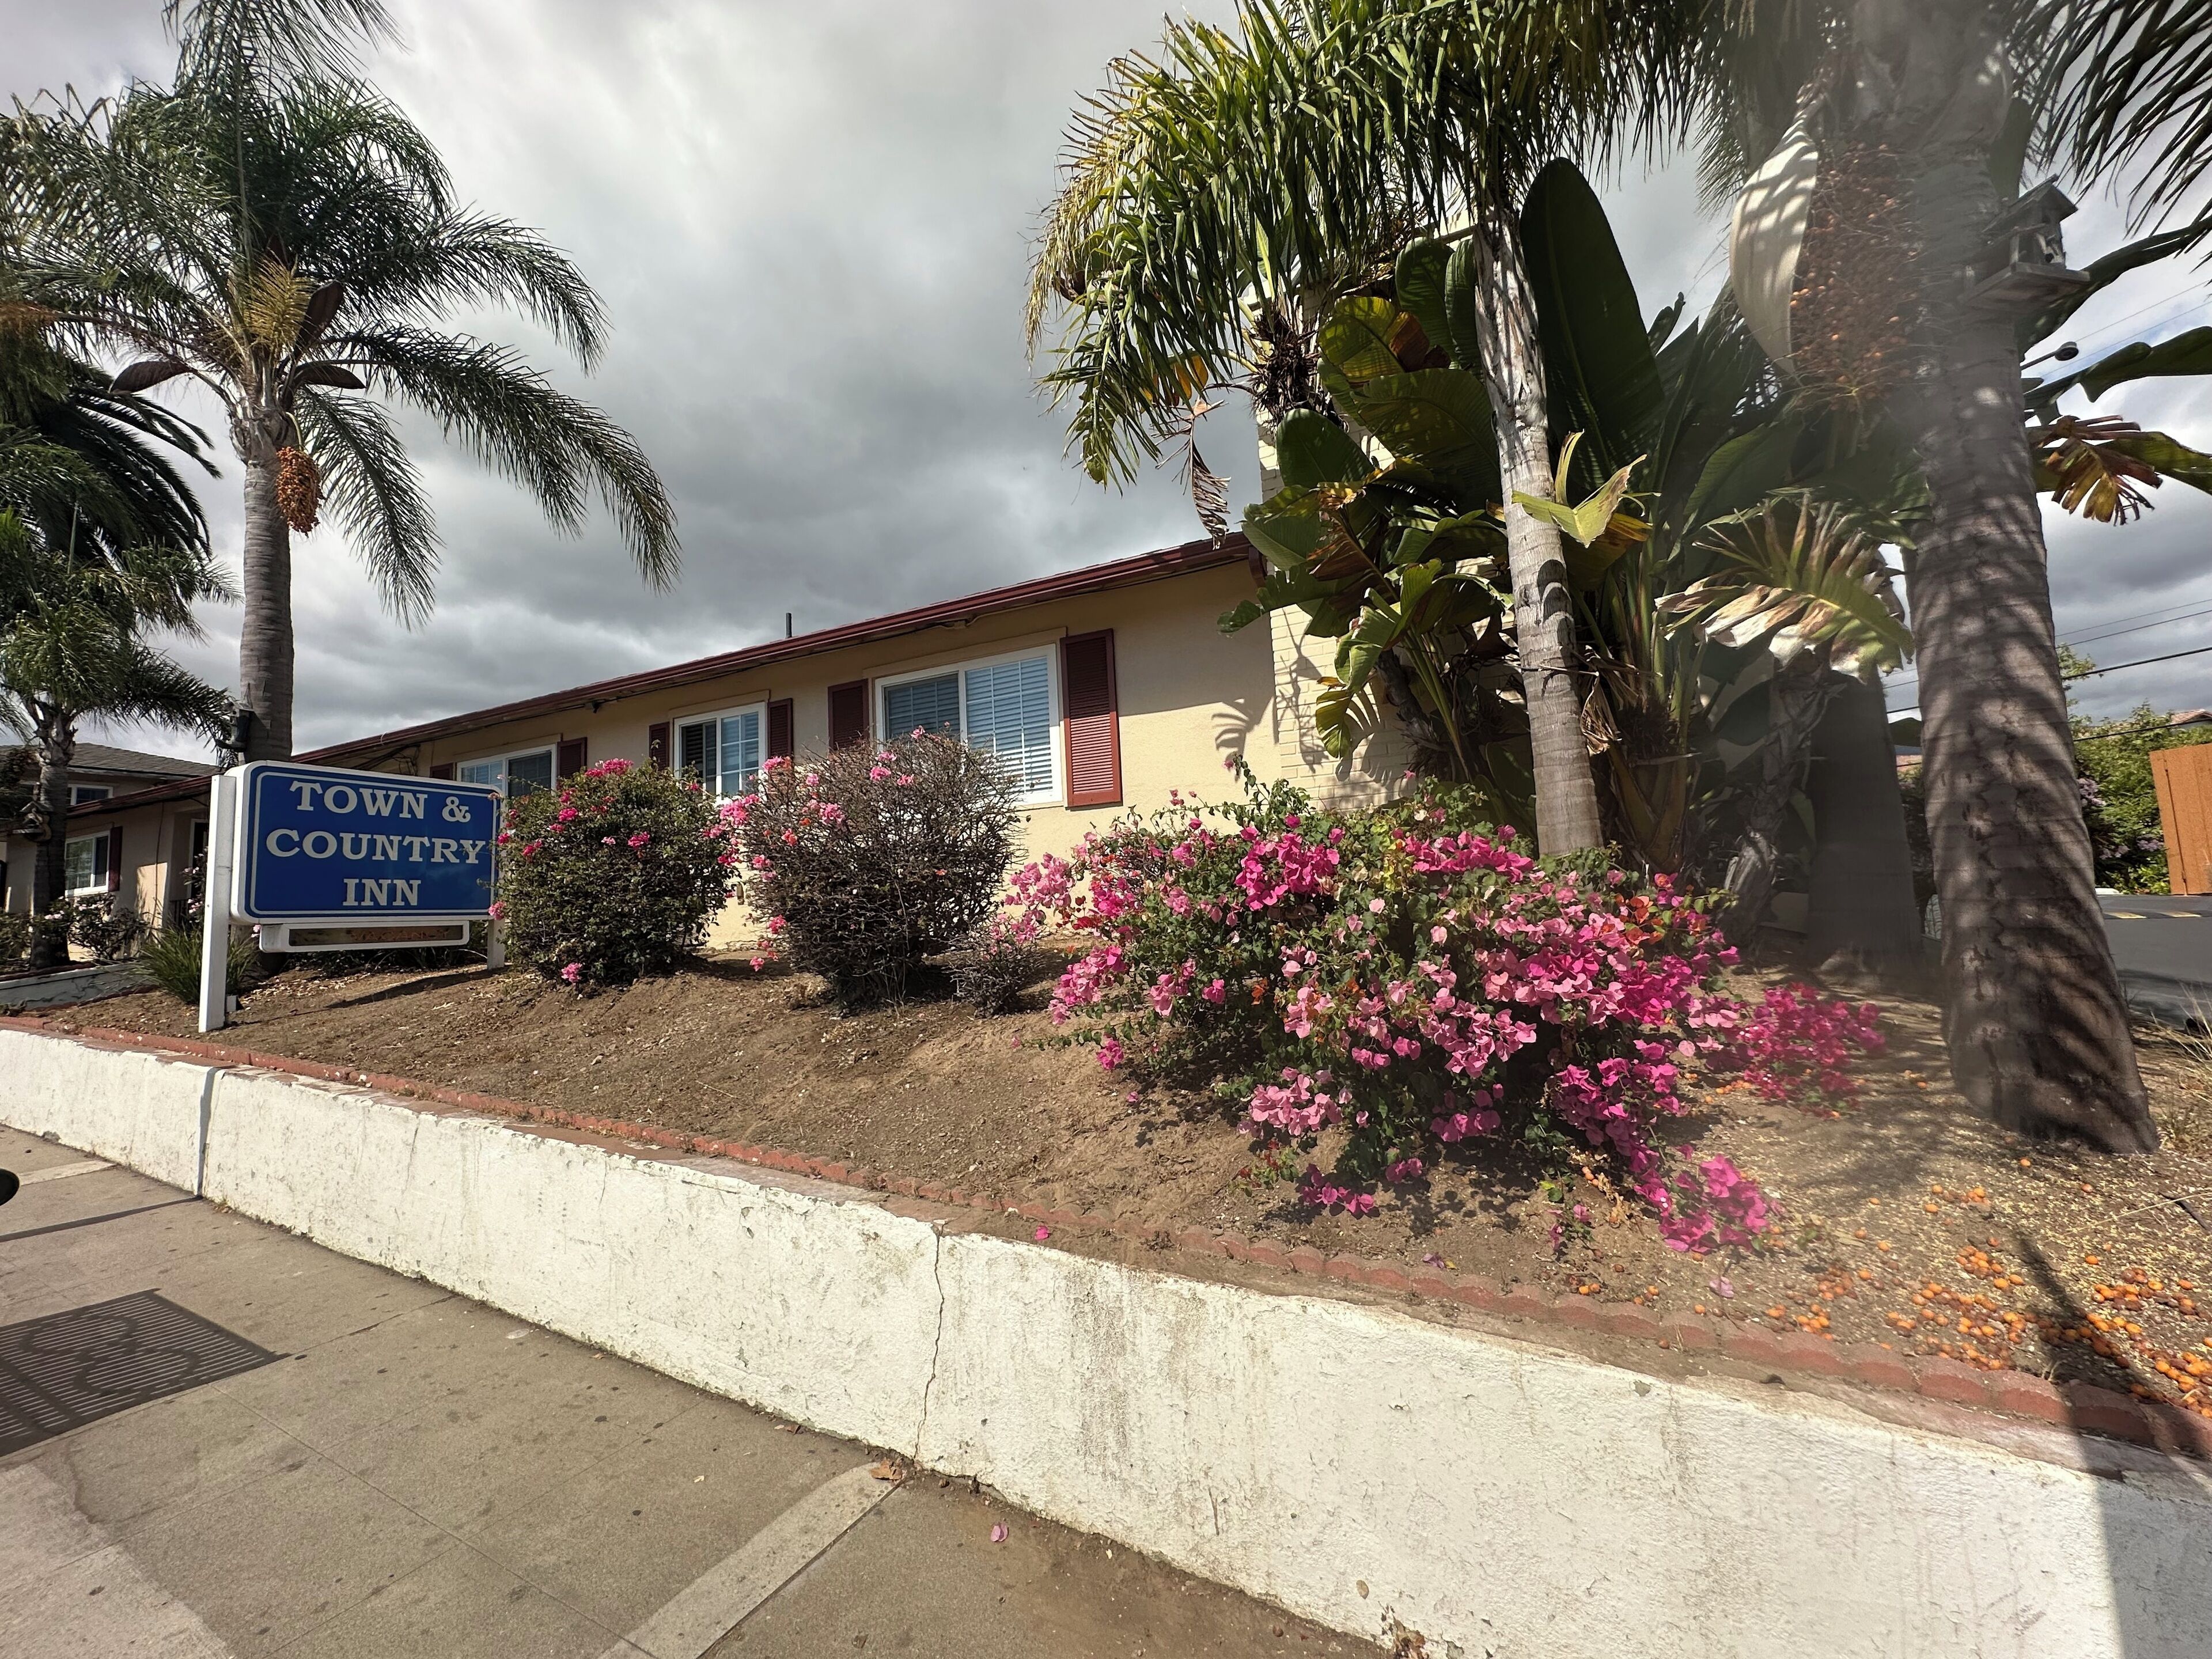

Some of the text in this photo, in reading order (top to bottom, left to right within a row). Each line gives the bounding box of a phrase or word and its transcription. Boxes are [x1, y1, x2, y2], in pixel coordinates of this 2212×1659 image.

[290, 781, 471, 823] TOWN &
[266, 829, 486, 864] COUNTRY
[343, 878, 421, 906] INN
